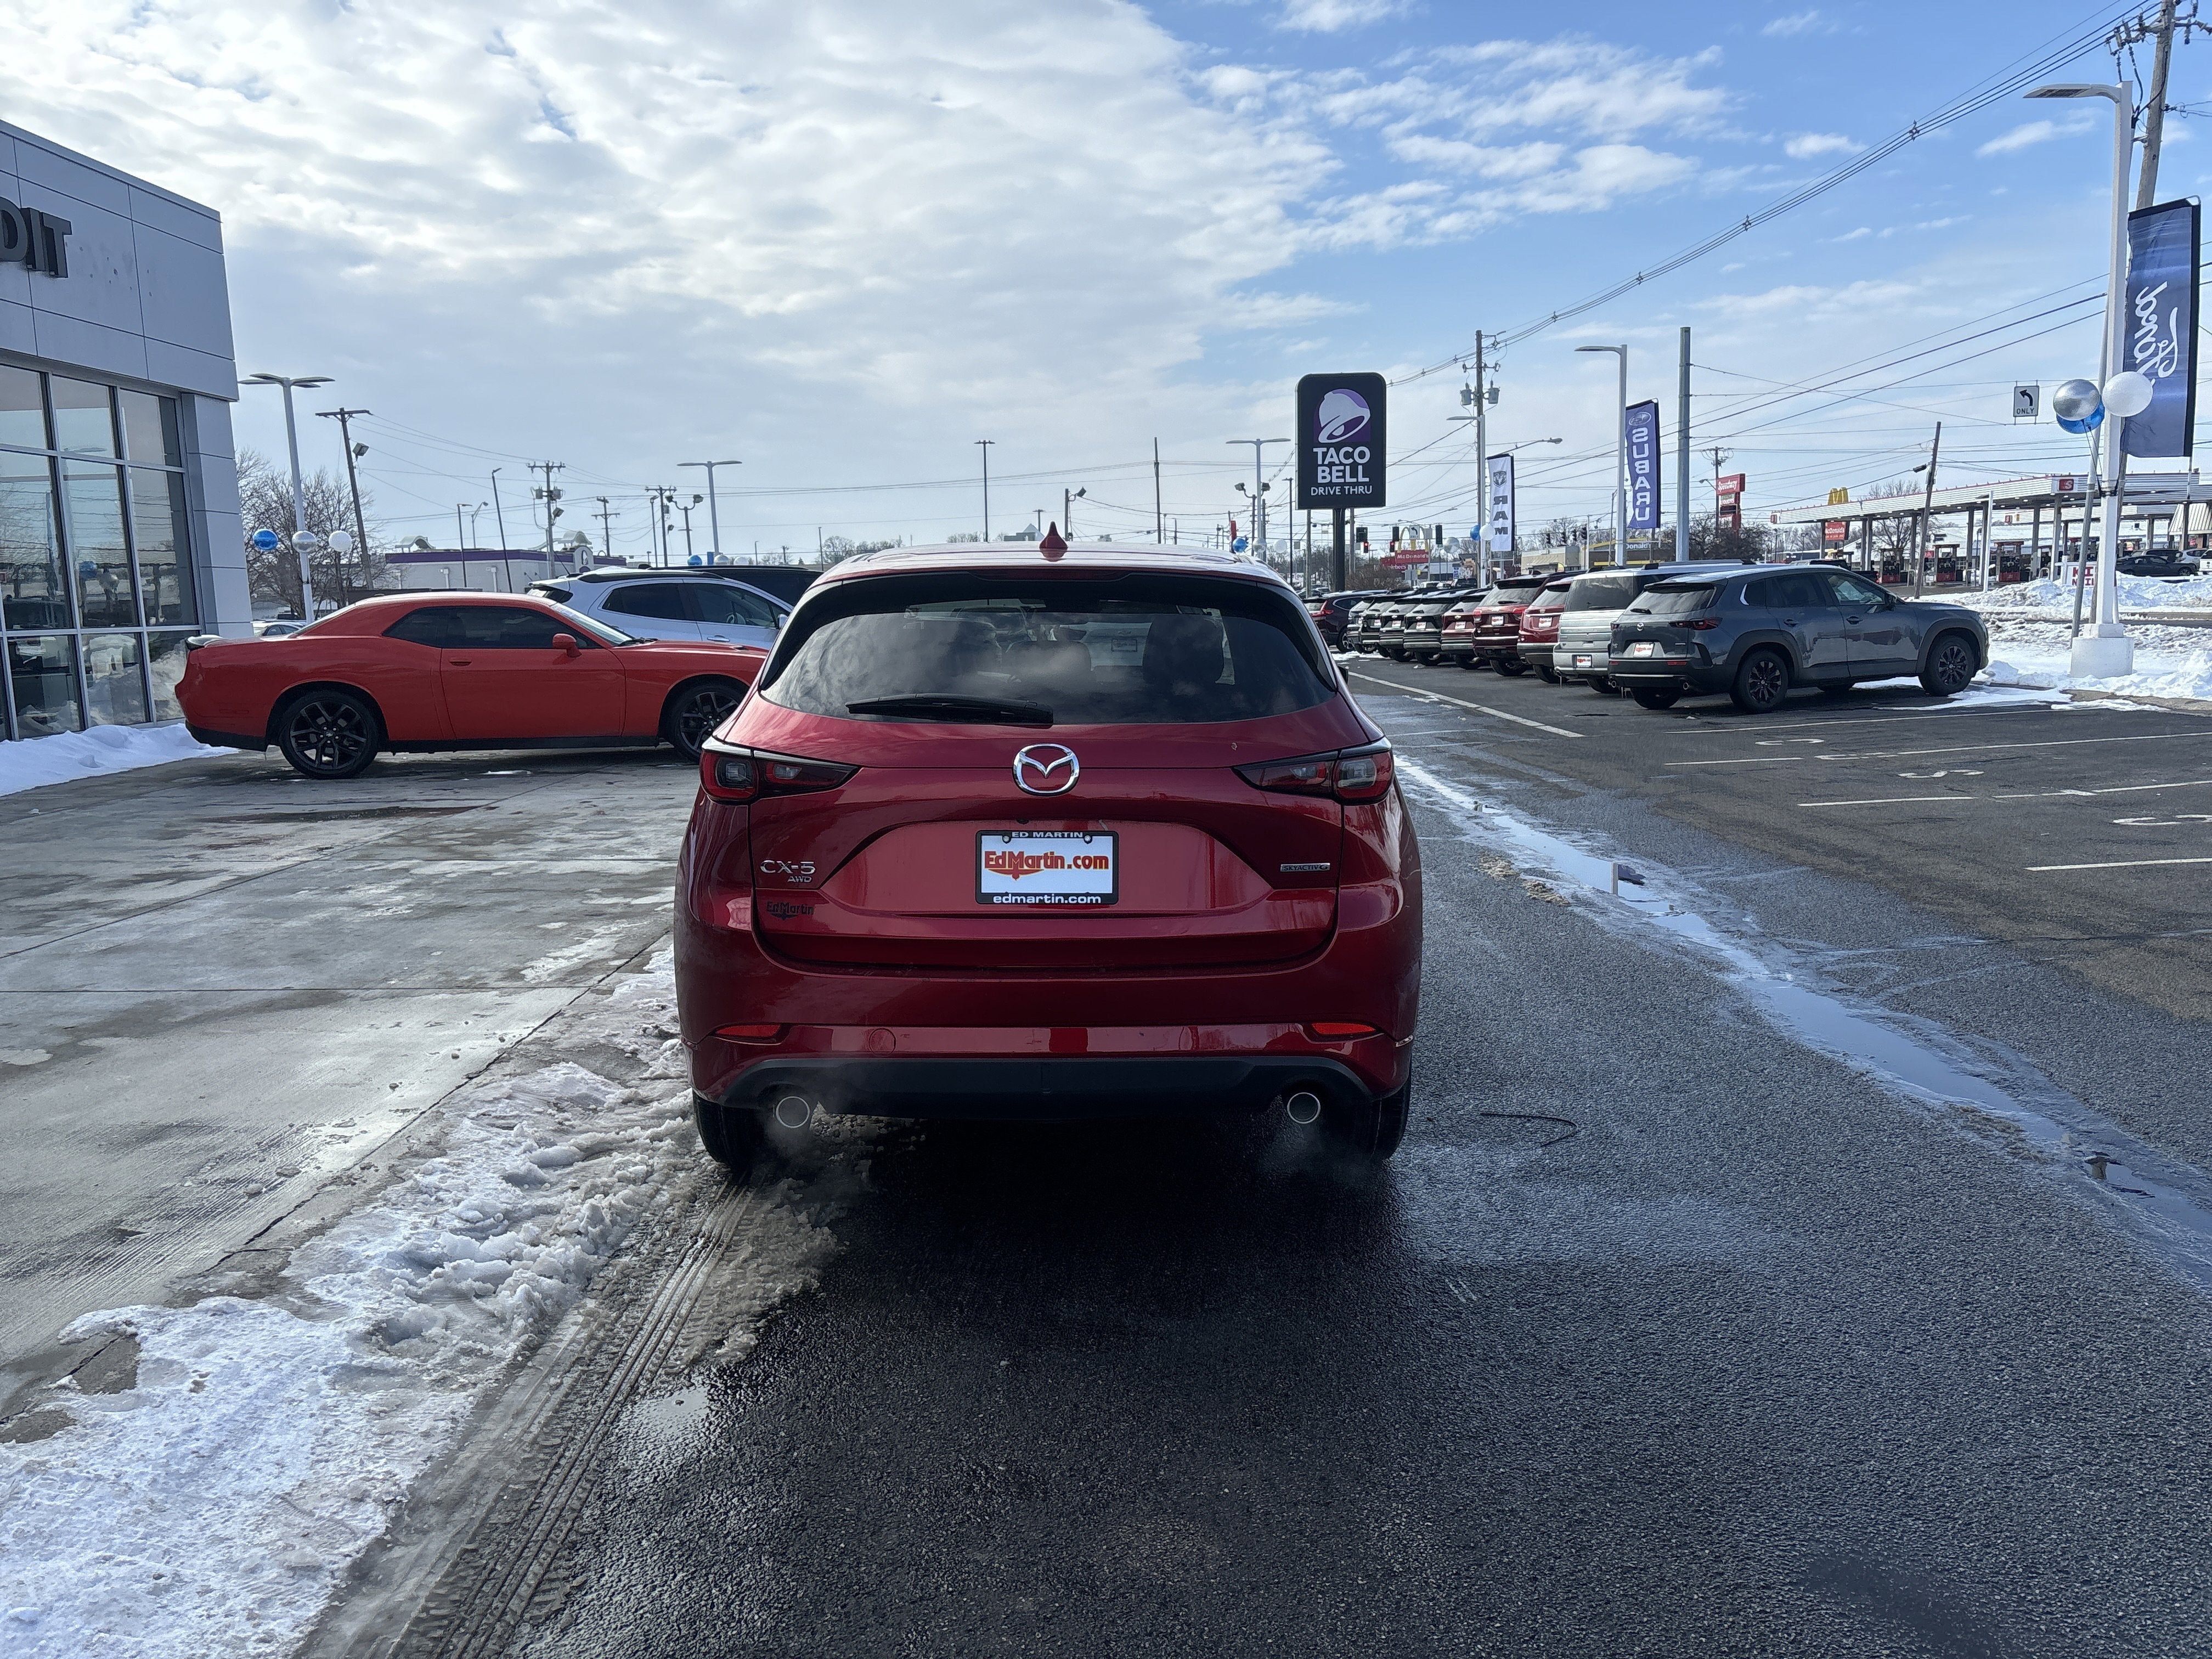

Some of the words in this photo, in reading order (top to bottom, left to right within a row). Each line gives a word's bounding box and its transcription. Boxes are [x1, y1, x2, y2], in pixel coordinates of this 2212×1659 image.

[1313, 446, 1370, 464] TACO
[1317, 465, 1369, 483] BELL
[1311, 486, 1341, 495] DRIVE
[1344, 485, 1372, 494] THRU
[760, 860, 816, 874] CX-5
[984, 851, 1109, 870] EdMartin.com
[993, 893, 1101, 904] edmartin.com
